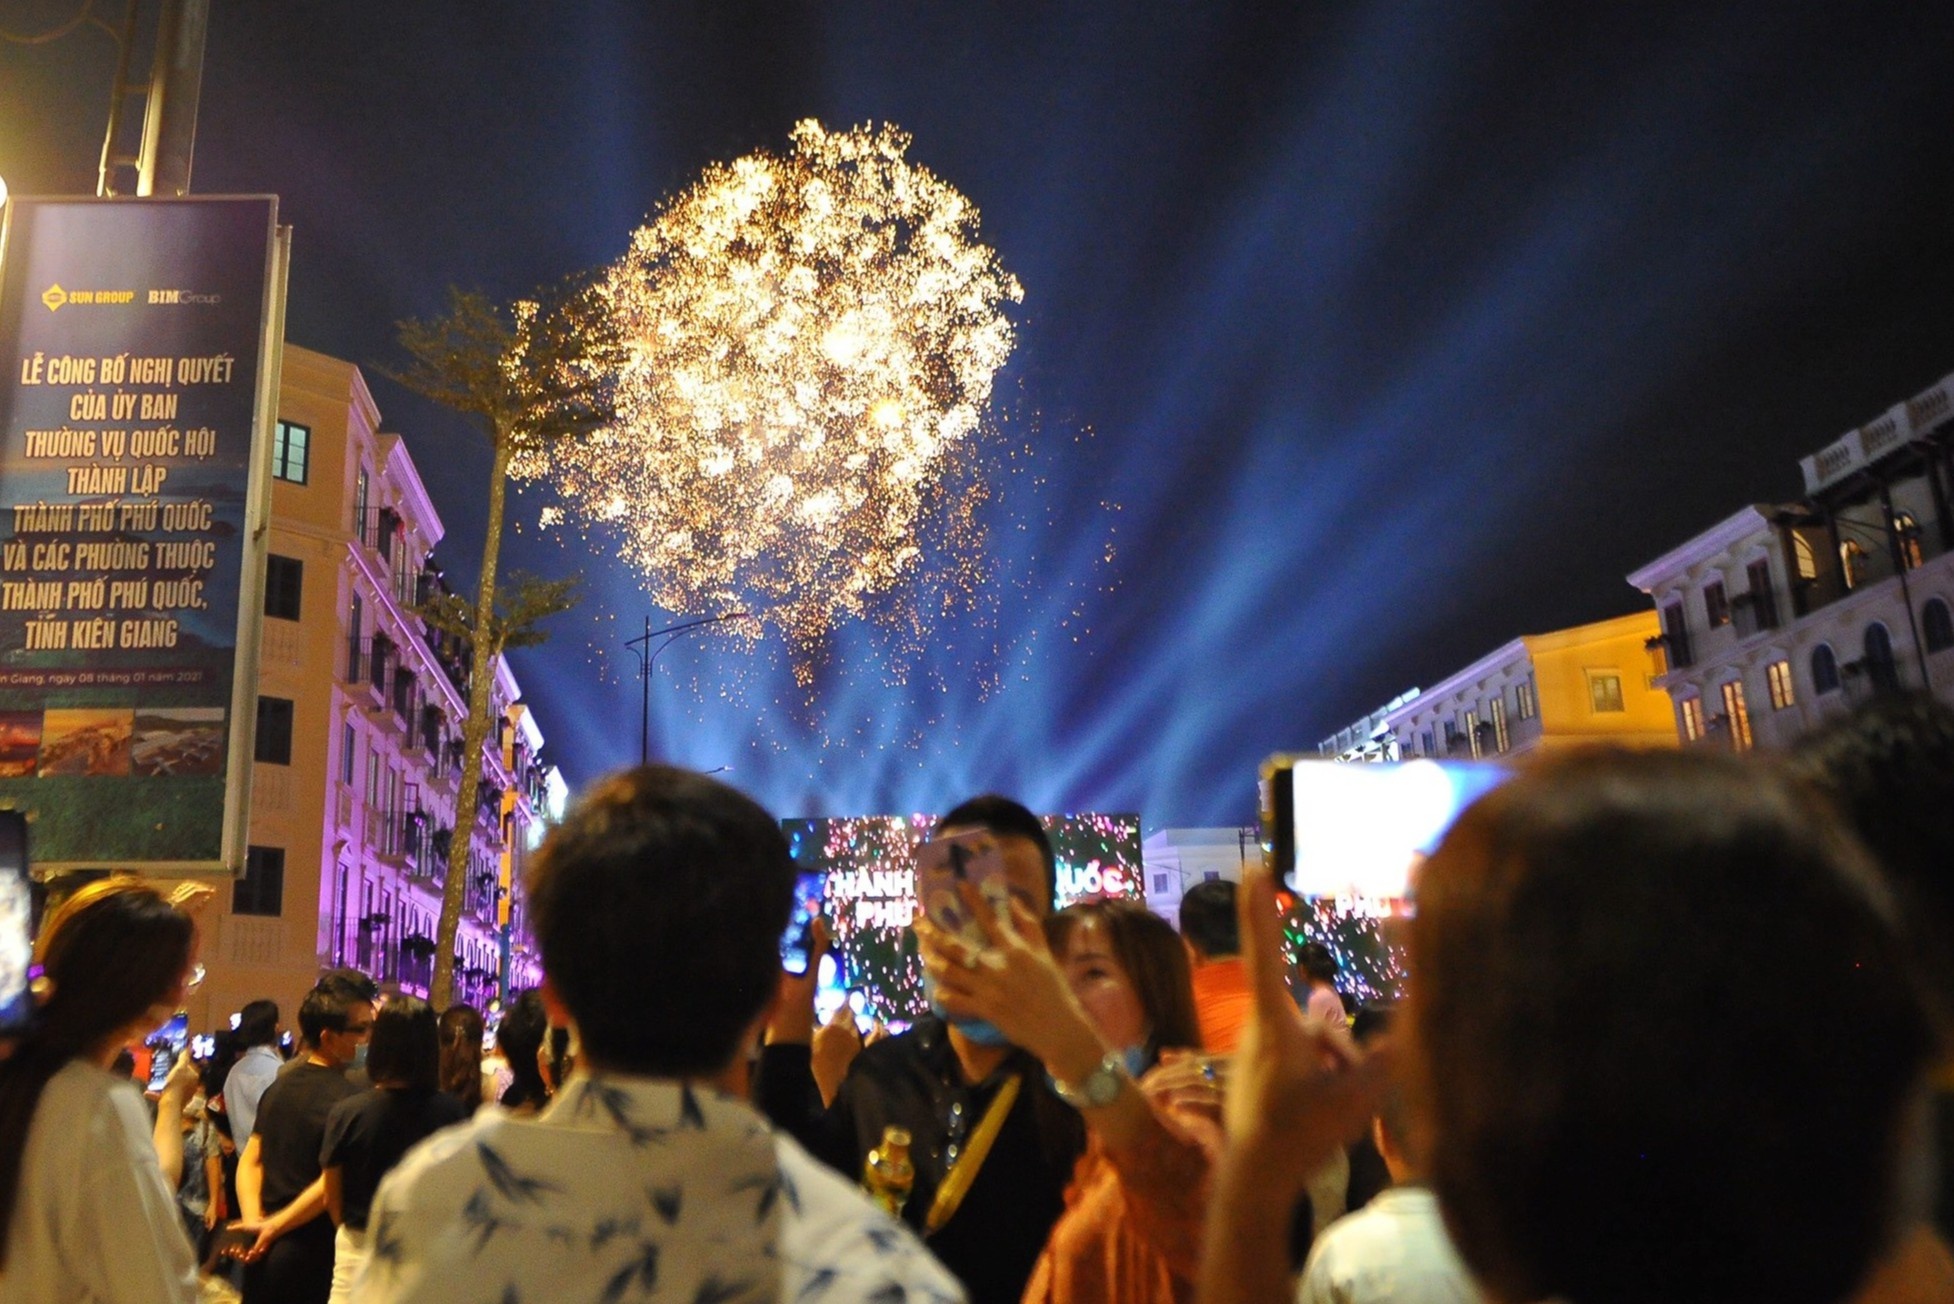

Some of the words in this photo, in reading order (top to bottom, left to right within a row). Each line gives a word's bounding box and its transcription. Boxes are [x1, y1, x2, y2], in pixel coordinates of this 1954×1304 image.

[69, 291, 94, 304] SUN
[95, 291, 135, 304] GROUP
[21, 352, 44, 385] LỄ
[47, 355, 95, 385] CÔNG
[100, 353, 129, 385] BỐ
[130, 358, 173, 387] NGHỊ
[177, 353, 234, 385] QUYẾT
[70, 389, 106, 421] CỦA
[112, 389, 137, 420] ỦY
[140, 394, 177, 420] BAN
[25, 426, 96, 457] THƯỜNG
[101, 430, 126, 461] VỤ
[130, 425, 179, 457] QUỐC
[184, 427, 216, 460] HỘI
[67, 463, 126, 494] THÀNH
[131, 464, 166, 497] LẬP
[14, 501, 73, 533] THÀNH
[77, 499, 119, 532] PHỐ
[119, 499, 158, 532] PHÚ
[162, 499, 213, 532] QUỐC
[4, 539, 27, 571] VÀ
[33, 539, 71, 571] CÁC
[75, 538, 150, 570] PHƯỜNG
[156, 539, 215, 574] THUỘC
[2, 578, 62, 610] THÀNH
[67, 575, 109, 610] PHỐ
[109, 577, 148, 609] PHÚ
[152, 574, 208, 610] QUỐC,
[25, 614, 68, 650] TỈNH
[72, 617, 116, 649] KIÊN
[120, 620, 178, 649] GIANG
